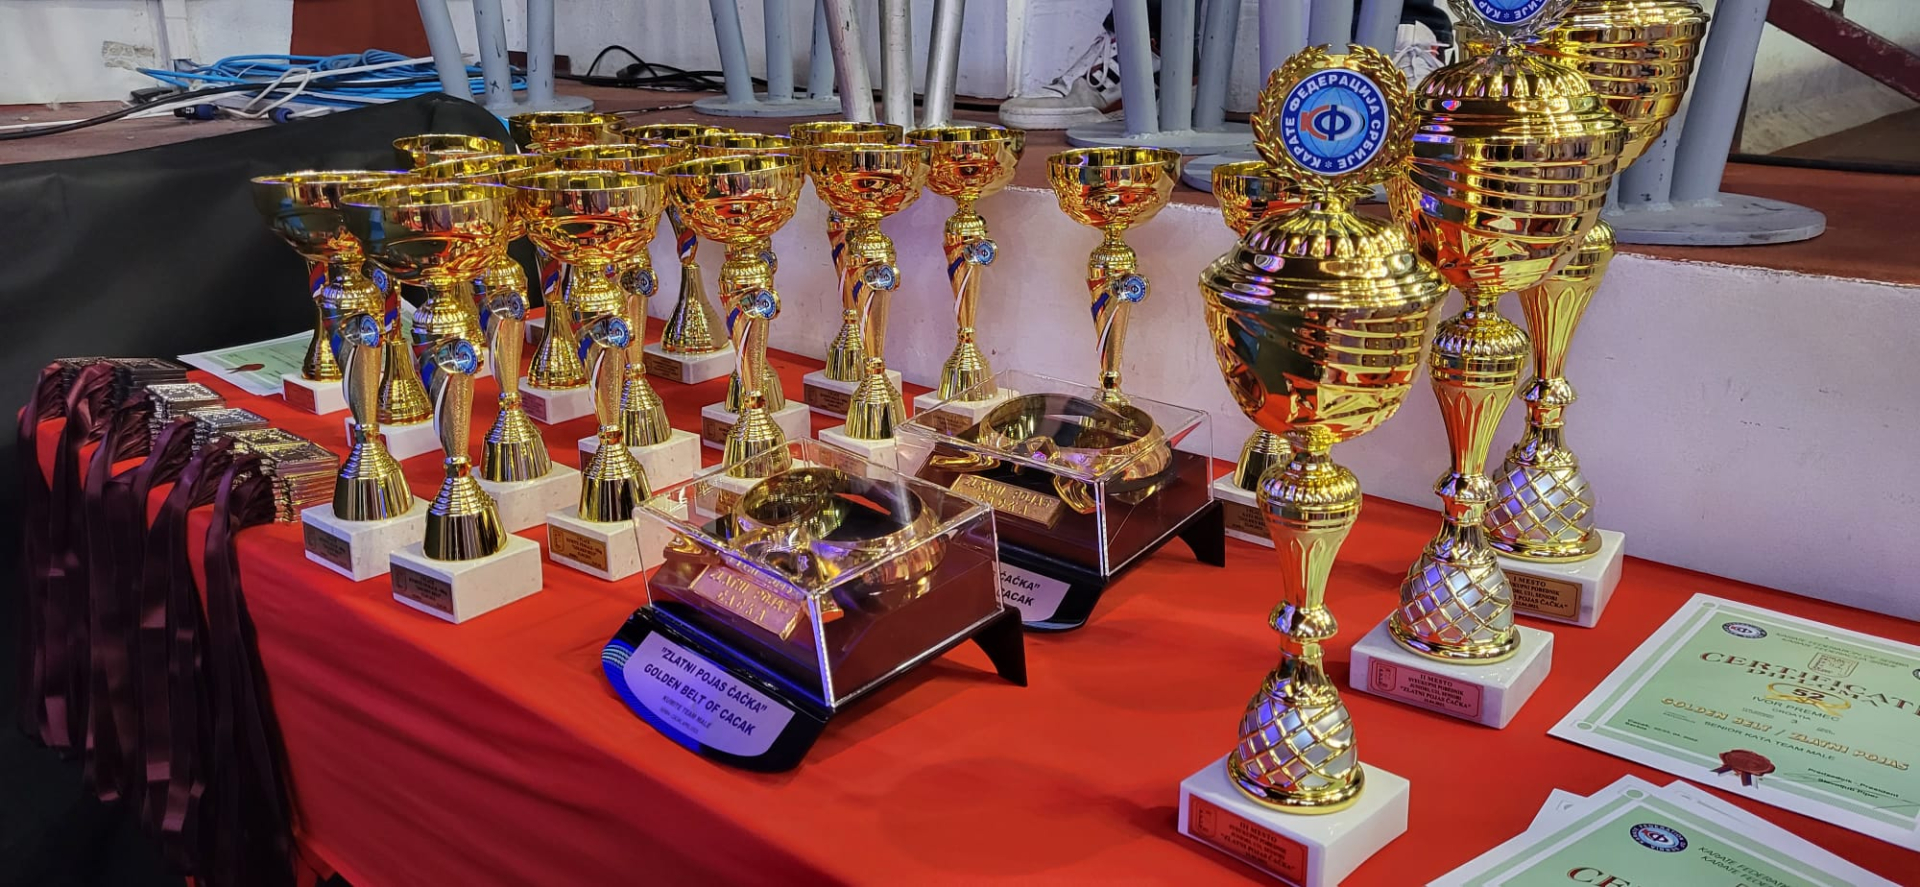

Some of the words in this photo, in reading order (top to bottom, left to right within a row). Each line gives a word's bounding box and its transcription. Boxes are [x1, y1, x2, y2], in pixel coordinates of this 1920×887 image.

[1289, 74, 1380, 115] ФЕДЕРАЦИЈА
[1285, 117, 1321, 168] КАРАТЕ
[1338, 119, 1381, 169] СРБИЈЕ
[1518, 577, 1546, 588] MESTO
[1518, 595, 1539, 604] POJAS
[661, 646, 698, 675] "ZLATNI
[695, 668, 728, 692] POJAS
[727, 684, 768, 714] ČAČKA"
[1428, 676, 1453, 687] MESTO
[644, 663, 682, 691] GOLDEN
[680, 684, 707, 705] BELT
[705, 700, 721, 713] OF
[719, 709, 756, 736] CACAK
[1426, 693, 1445, 702] POJAS
[1792, 688, 1826, 702] 52
[1752, 695, 1783, 709] IVOR
[1785, 704, 1842, 722] PREMEC
[1772, 707, 1812, 721] CROATIA
[1661, 697, 1728, 721] GOLDEN
[1732, 717, 1773, 733] BELT
[1788, 731, 1850, 754] ZLATNI
[1852, 749, 1910, 771] POJAS
[1705, 721, 1742, 735] SENIOR
[1744, 732, 1772, 744] KATA
[1775, 740, 1804, 752] TEAM
[1806, 750, 1836, 761] MALE
[1860, 783, 1899, 798] President
[1240, 821, 1249, 831] III
[1250, 826, 1277, 843] MESTO
[1698, 846, 1738, 864] KARATE
[1701, 855, 1740, 874] KARATE
